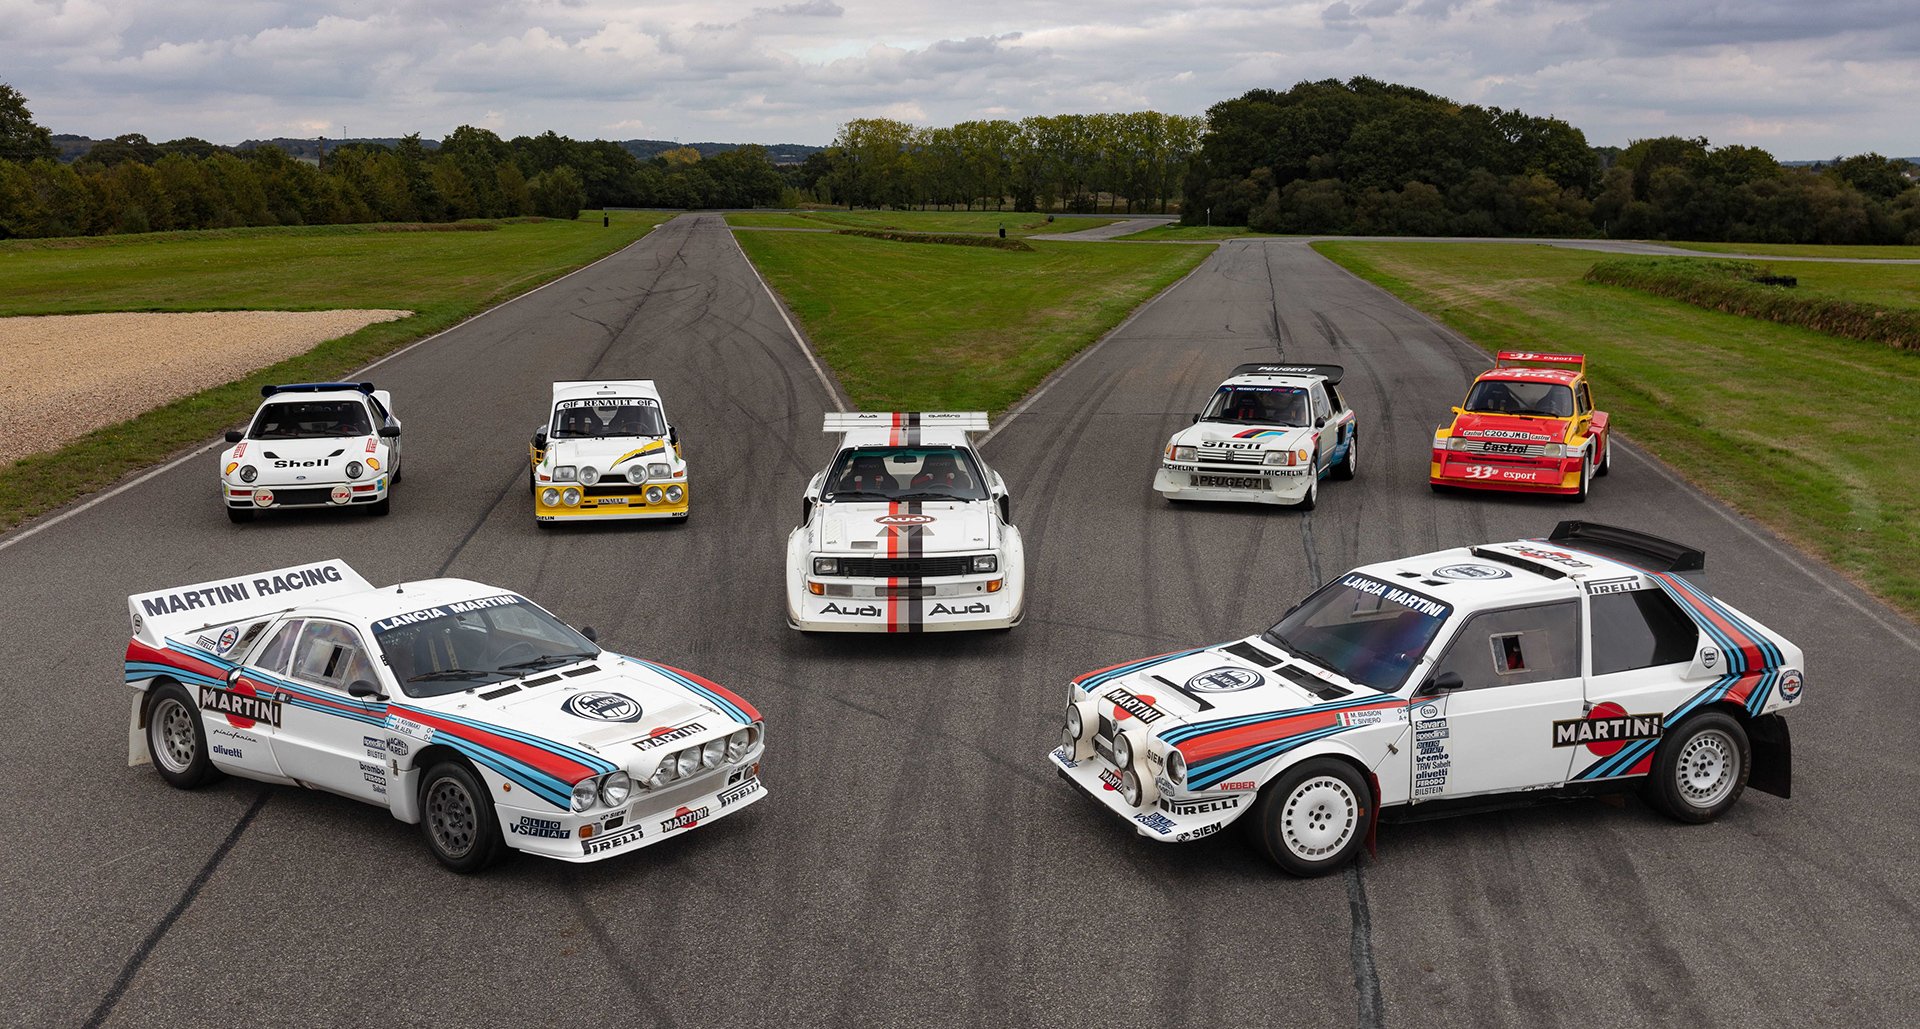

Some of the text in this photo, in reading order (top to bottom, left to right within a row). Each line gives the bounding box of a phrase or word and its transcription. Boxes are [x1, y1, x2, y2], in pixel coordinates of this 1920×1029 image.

[563, 400, 579, 409] elf
[584, 399, 632, 407] RENAULT
[1484, 430, 1528, 440] C206 JMB
[1202, 441, 1262, 450] Shell
[1483, 442, 1528, 454] Castrol
[273, 459, 329, 469] Shell
[1201, 475, 1261, 489] PEUGEOT
[1503, 470, 1537, 481] export
[880, 515, 931, 525] Audi
[141, 565, 343, 618] MARTINI RACING
[1584, 575, 1641, 595] PIRELLI
[1342, 575, 1447, 618] LANCIA MARTINI
[377, 594, 520, 631] LANCIA MARTINI
[819, 602, 882, 618] Audi
[928, 602, 991, 617] Audi
[201, 688, 280, 724] MARTINI
[1109, 690, 1159, 723] MARTINI
[1357, 710, 1382, 718] BIASION
[639, 722, 707, 751] MARTINI
[1557, 716, 1660, 744] MARTINI
[213, 745, 243, 759] olivetti
[1146, 748, 1164, 767] SIEM
[1416, 753, 1449, 763] brembo
[1416, 763, 1431, 772] TRW
[1416, 768, 1448, 780] olivetti
[1220, 781, 1256, 791] WEBER
[1416, 778, 1445, 788] FERODO
[717, 776, 760, 809] PIRELLI
[1415, 786, 1443, 796] BILSTEIN
[1168, 794, 1240, 816] PIRELLI
[610, 809, 627, 818] SIEM
[662, 806, 709, 833] MARTINI
[521, 816, 561, 830] OLIO
[1192, 821, 1223, 839] SIEM
[581, 824, 644, 856] PIRELLI
